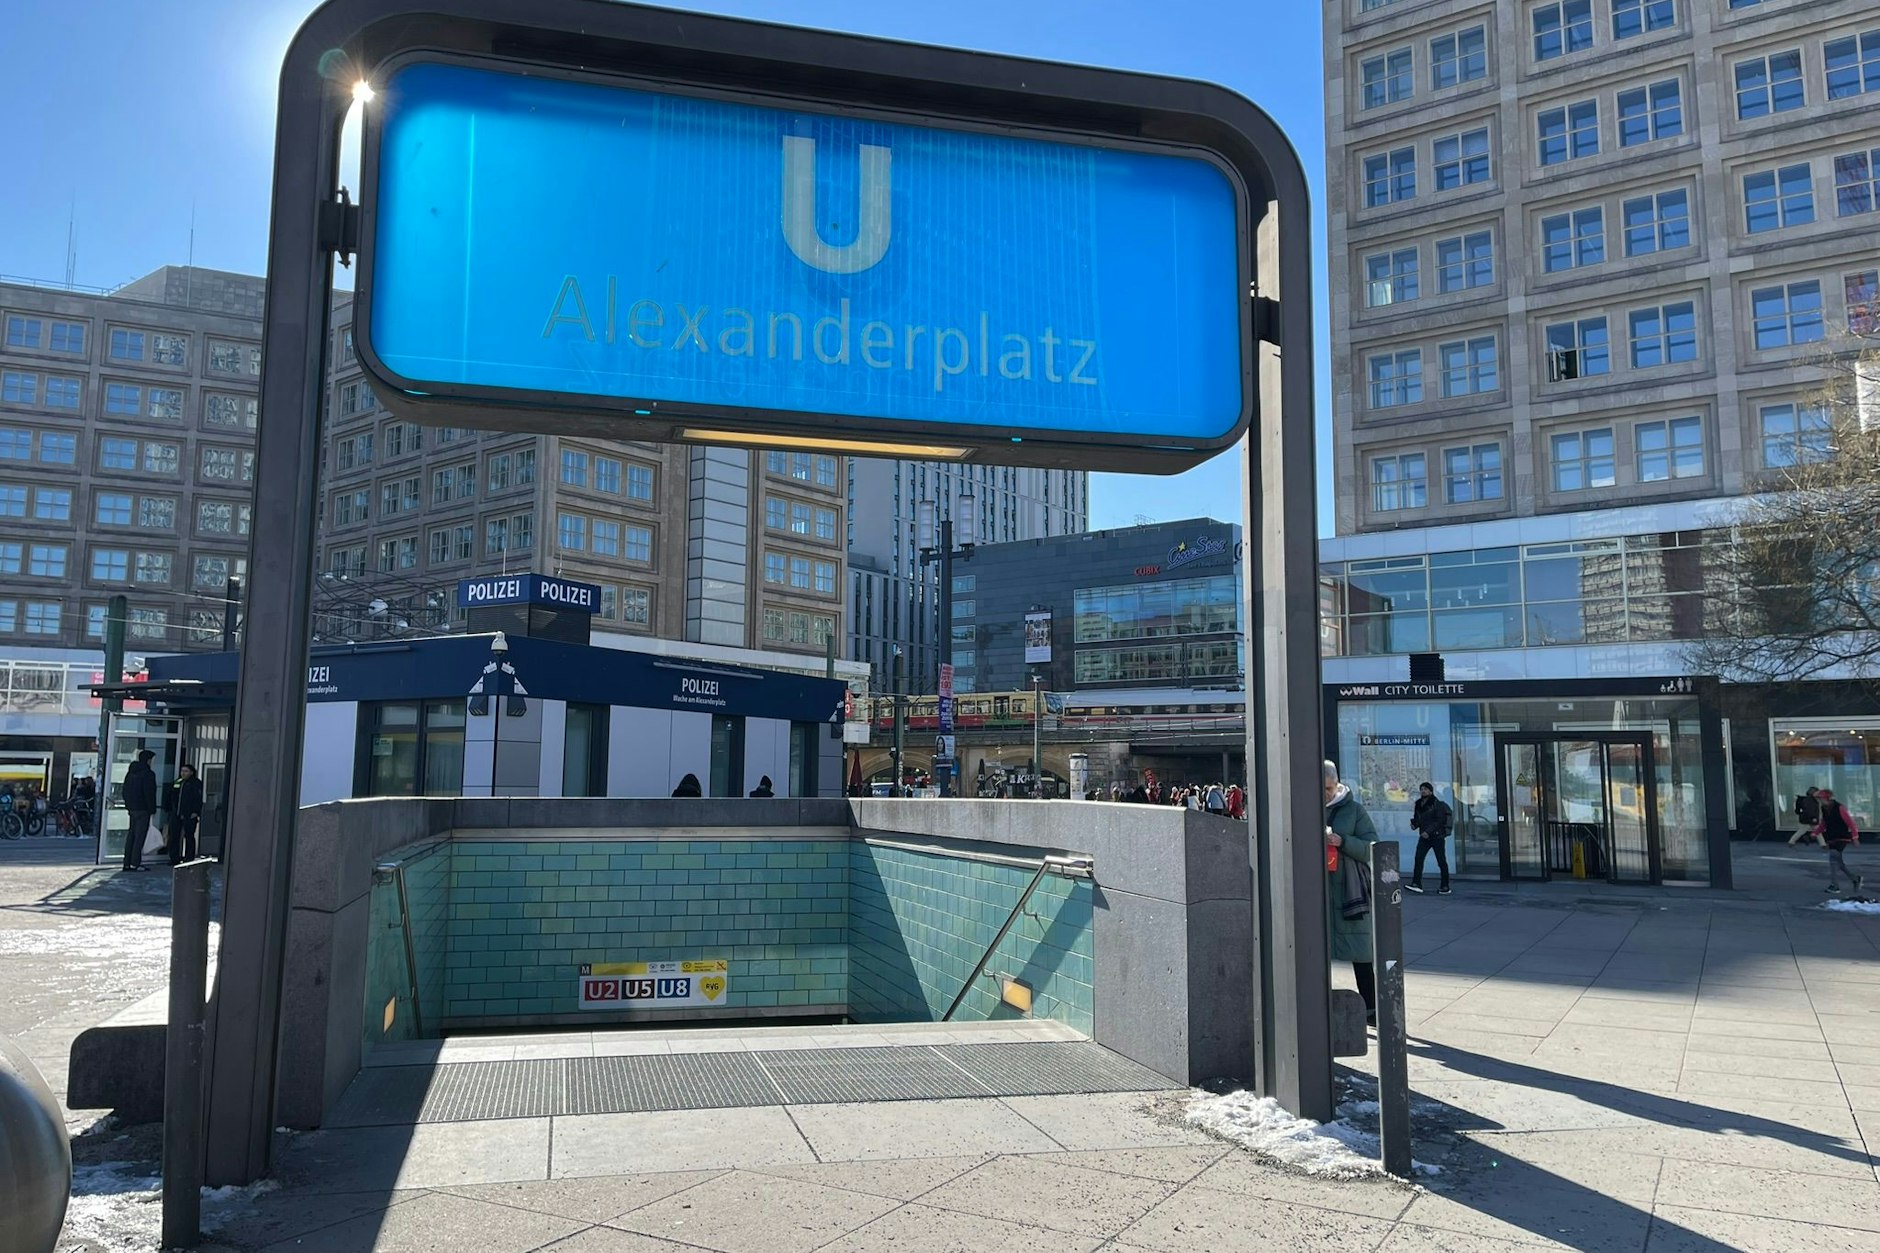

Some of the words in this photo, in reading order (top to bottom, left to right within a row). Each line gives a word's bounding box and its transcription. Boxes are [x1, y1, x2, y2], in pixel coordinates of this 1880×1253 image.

[782, 135, 891, 274] U
[540, 275, 1098, 391] Alexanderplatz
[468, 580, 520, 601] POLIZEI
[541, 581, 591, 606] POLIZEI
[308, 666, 330, 683] IZEI
[682, 677, 719, 696] POLIZEI
[1352, 686, 1379, 696] Wall
[1384, 686, 1409, 696] CITY
[1413, 684, 1465, 695] TOILETTE
[581, 965, 590, 975] M
[589, 982, 615, 999] U2
[625, 980, 651, 998] U5
[661, 979, 687, 996] U8
